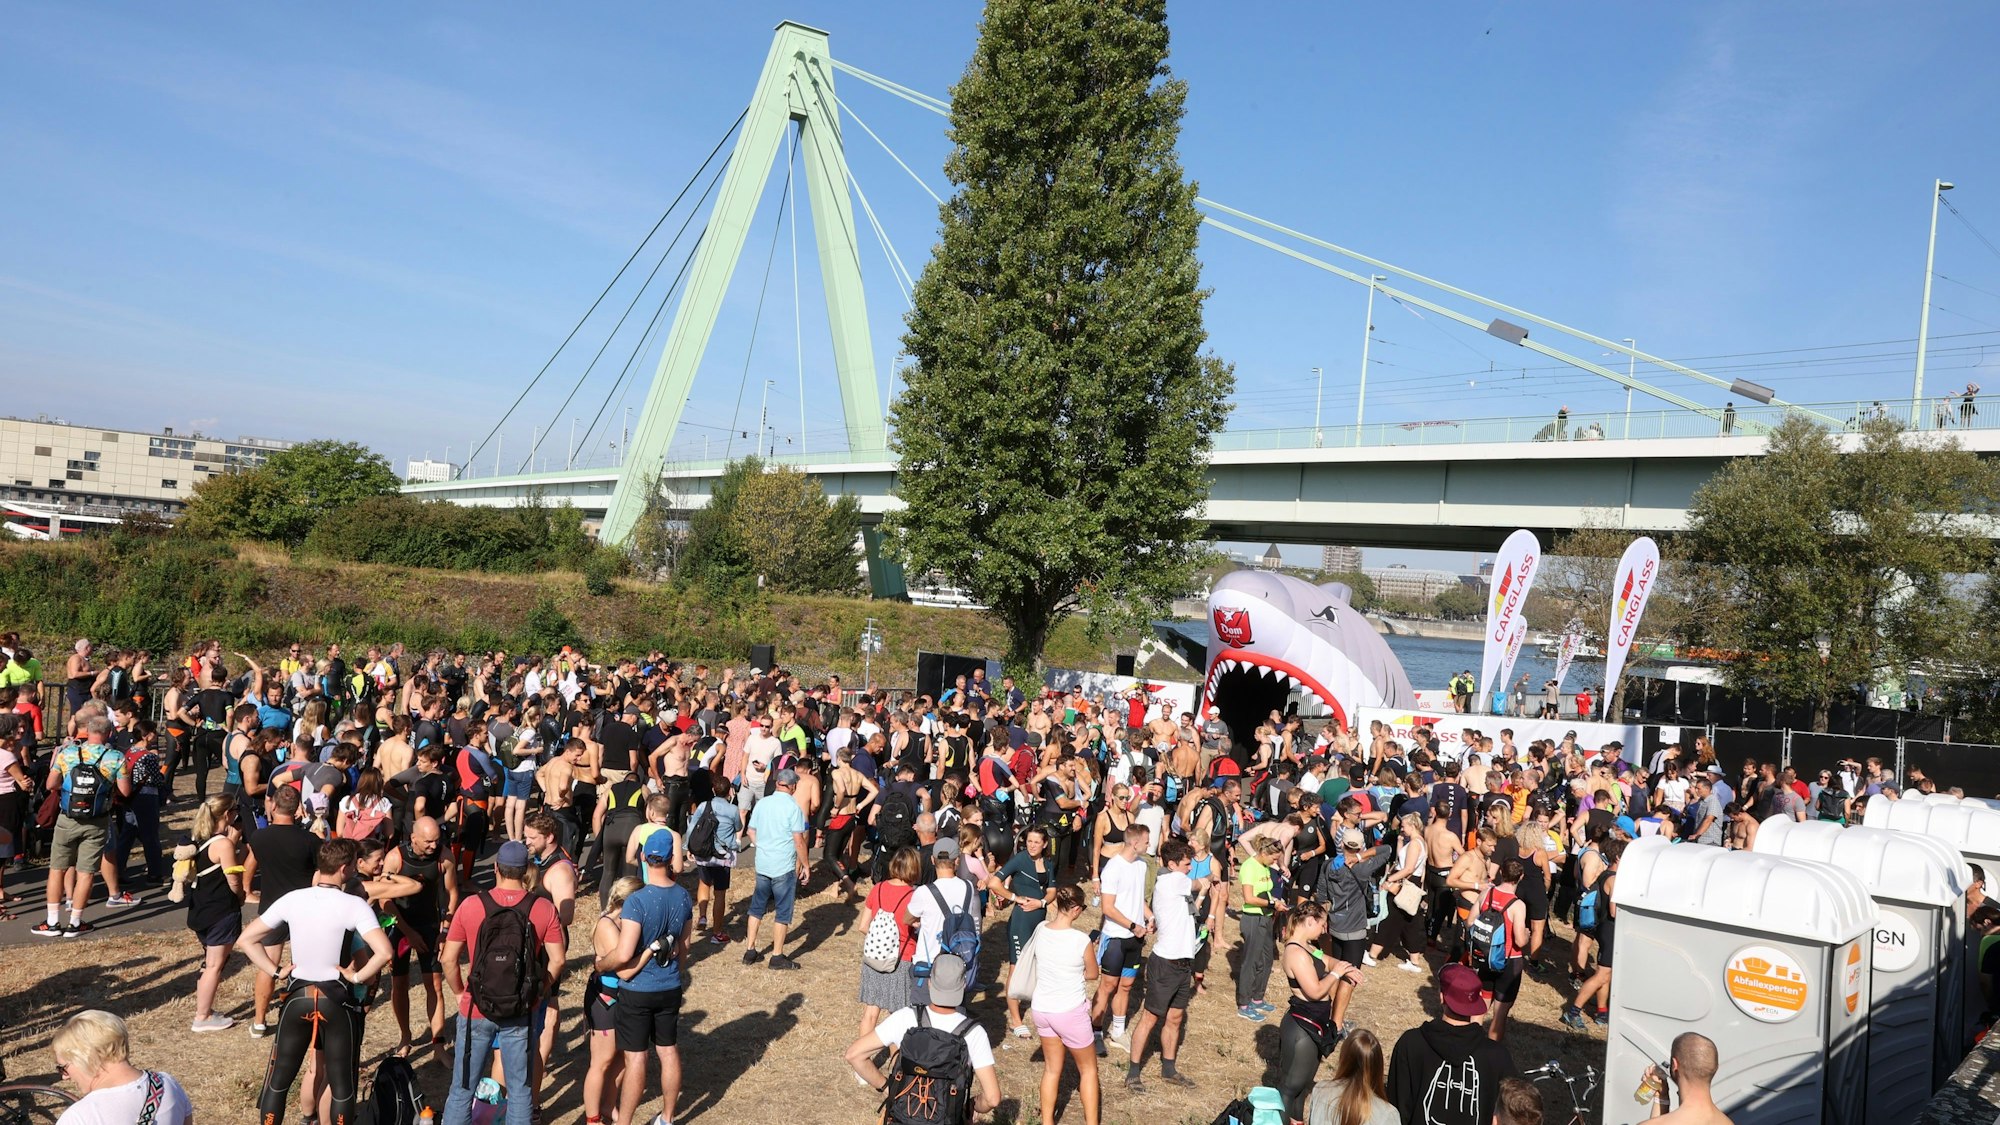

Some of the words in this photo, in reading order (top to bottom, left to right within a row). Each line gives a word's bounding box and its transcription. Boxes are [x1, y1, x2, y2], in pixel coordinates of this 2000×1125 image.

[1495, 553, 1534, 642] CARGLASS
[1617, 559, 1654, 647] CARGLASS
[1220, 623, 1243, 635] Dom
[1506, 625, 1525, 668] CARGLASS
[1873, 929, 1905, 947] GN
[1733, 975, 1799, 996] Abfallexperten
